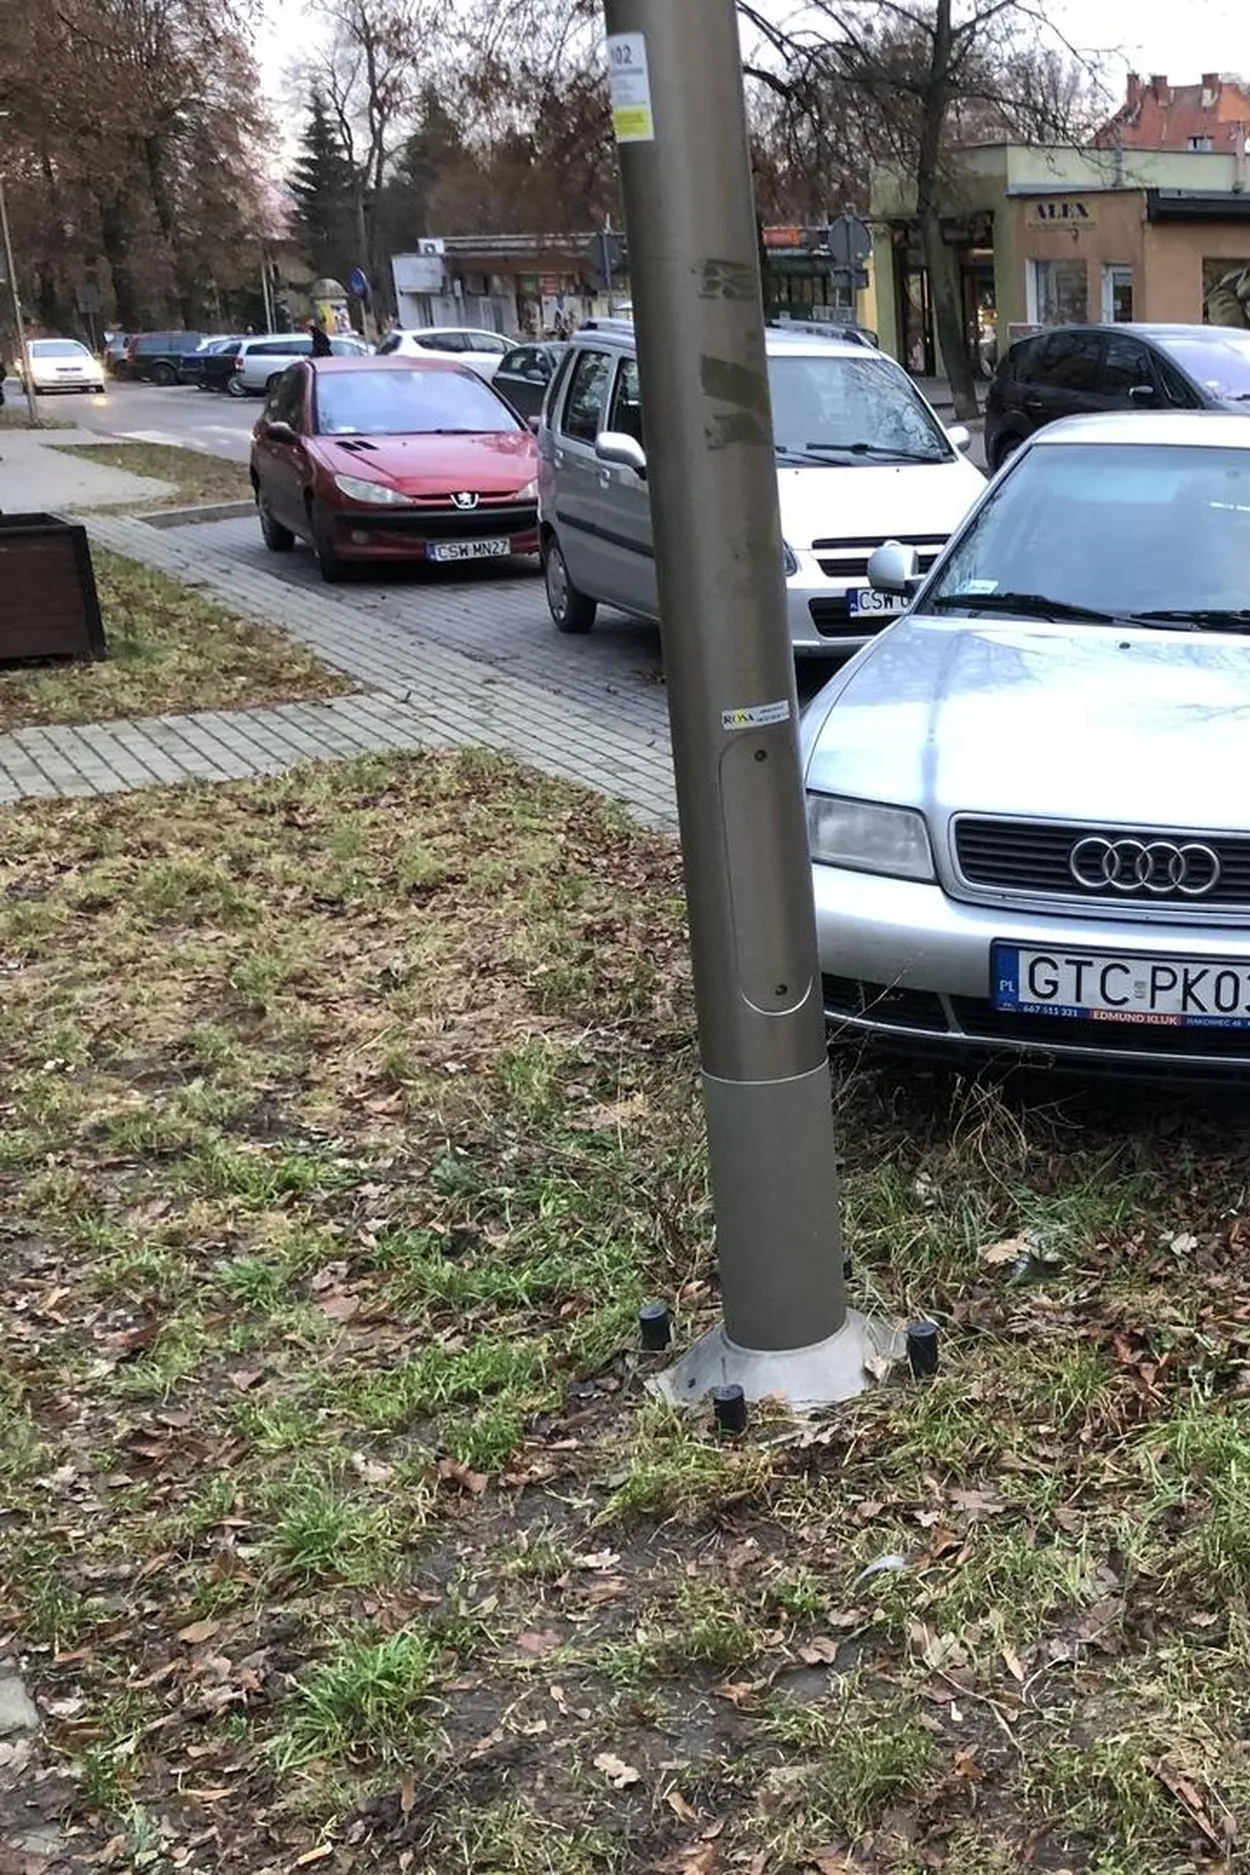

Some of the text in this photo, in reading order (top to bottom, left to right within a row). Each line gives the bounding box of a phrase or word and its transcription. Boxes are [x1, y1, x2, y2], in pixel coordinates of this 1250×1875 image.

[438, 541, 508, 559] CSW MN27
[1028, 955, 1132, 1006] GTC
[1093, 1010, 1146, 1024] EDMUND
[1147, 1013, 1179, 1026] KLUK
